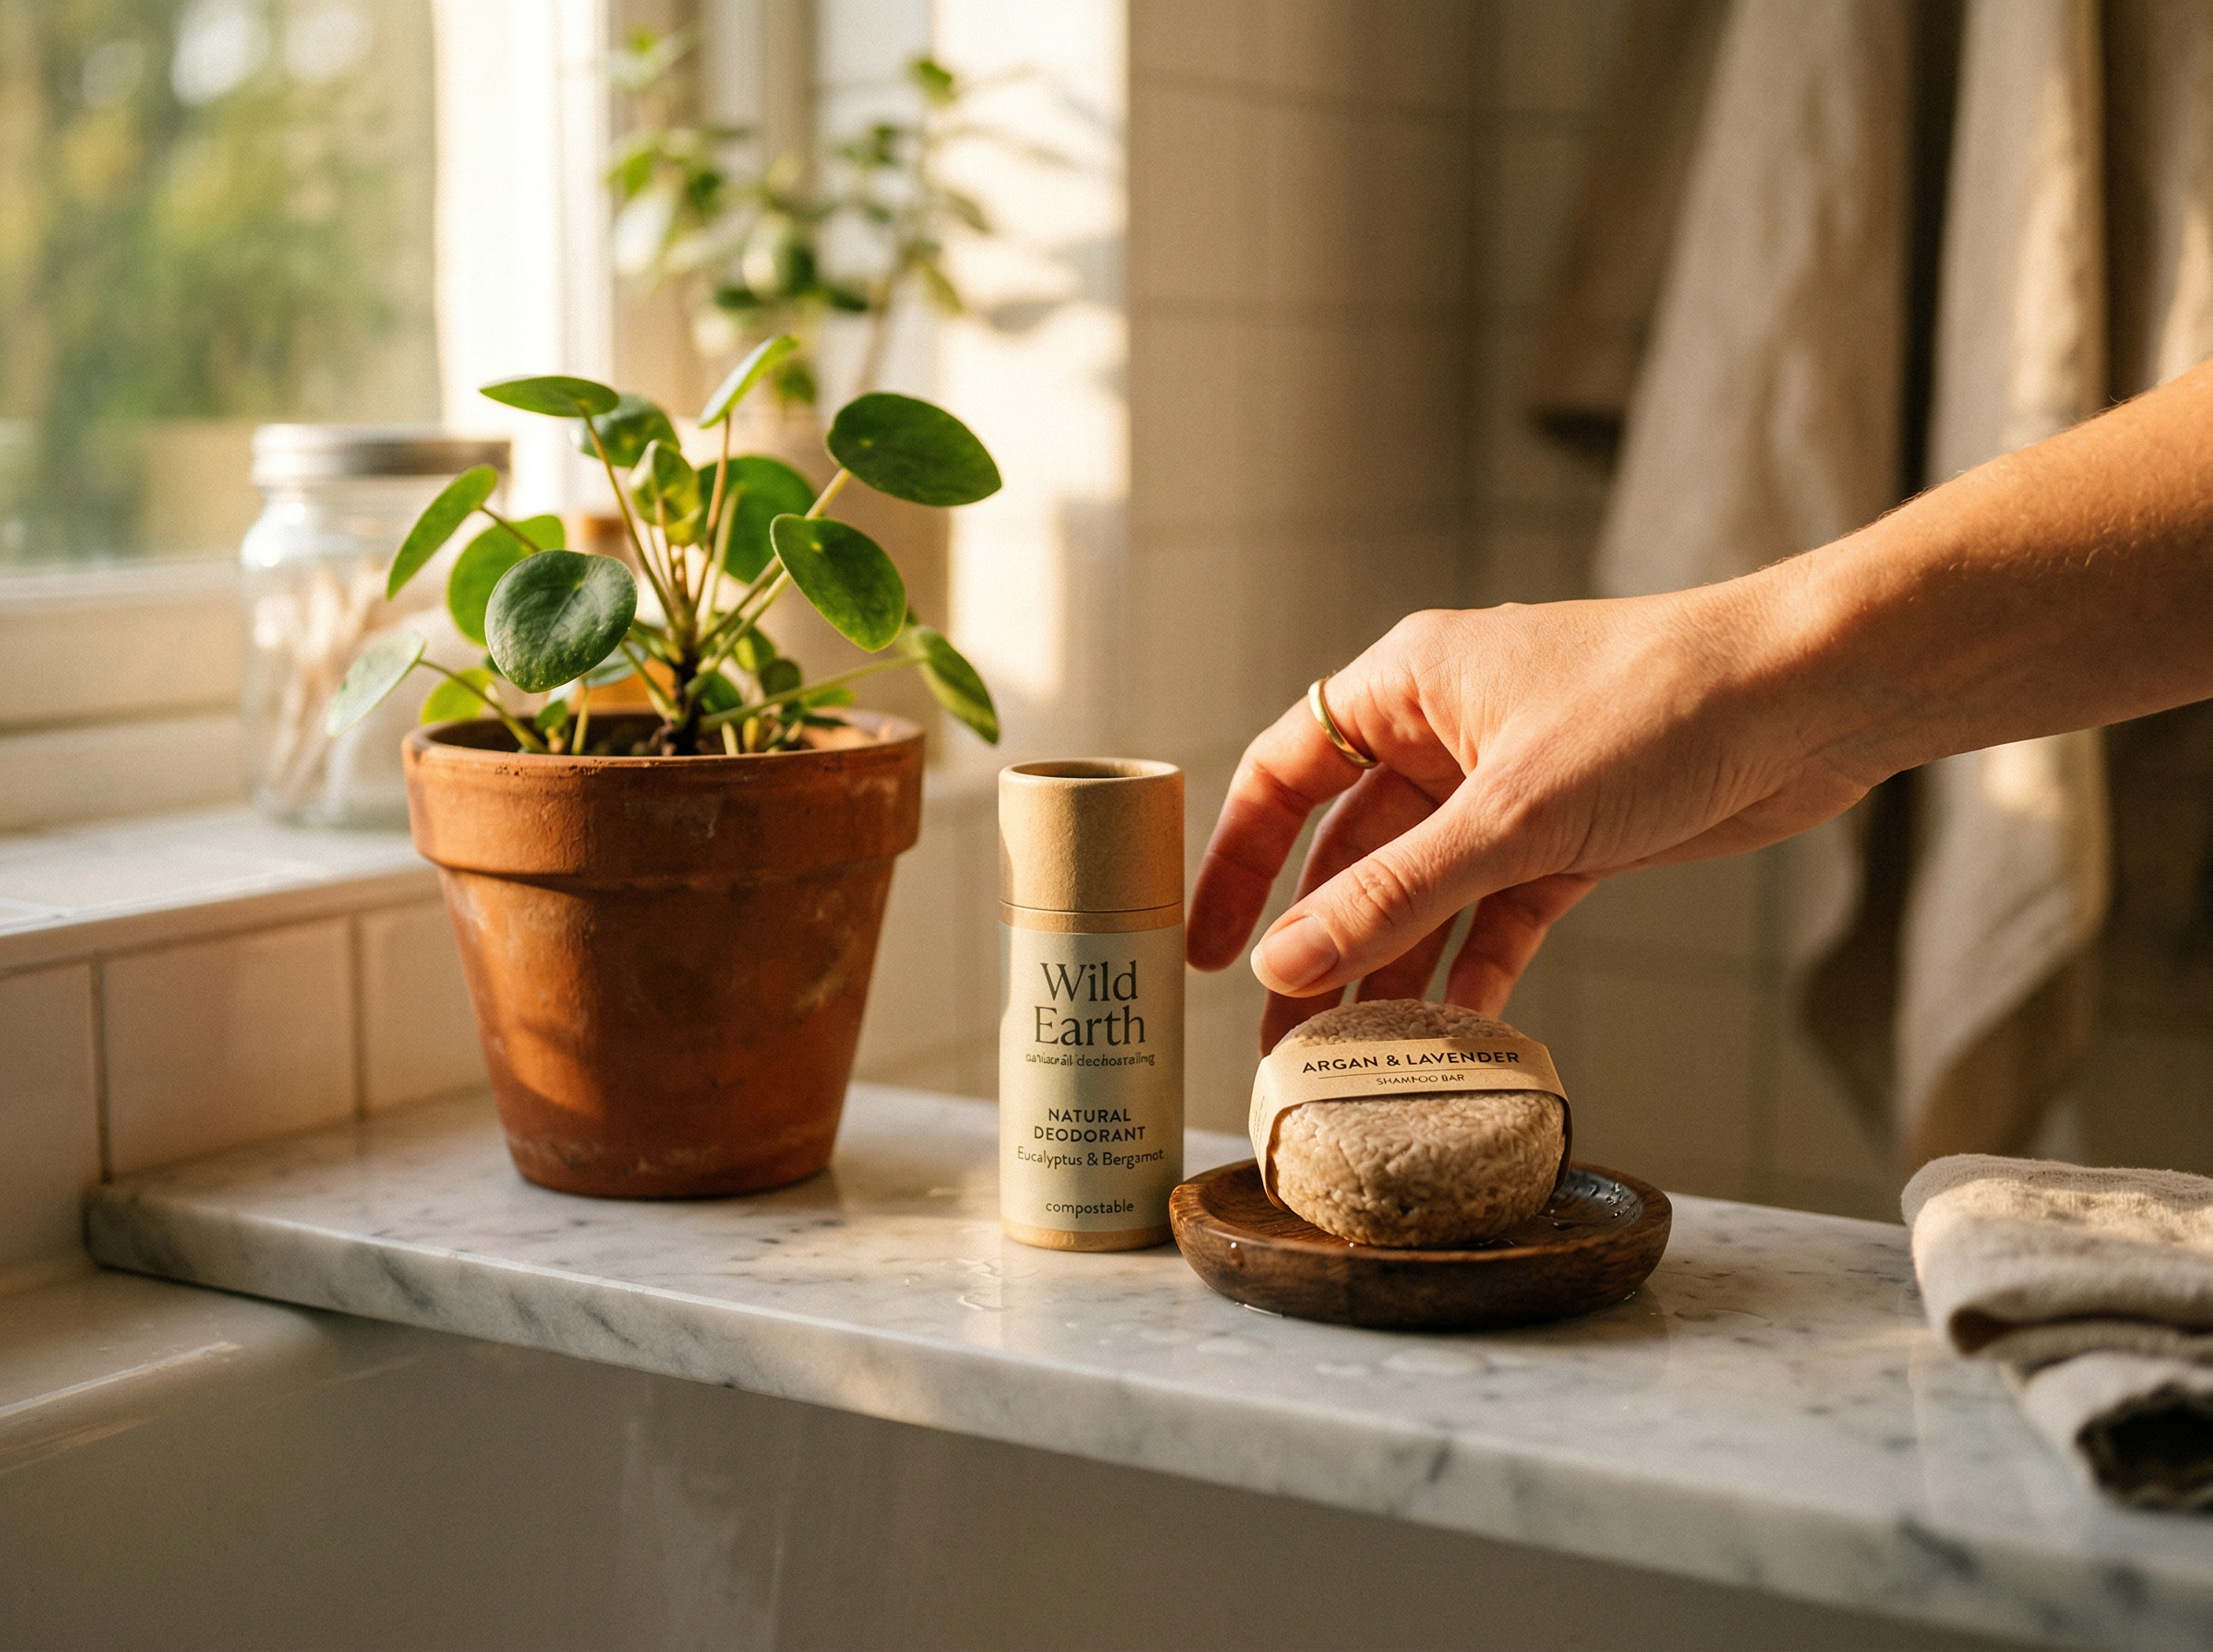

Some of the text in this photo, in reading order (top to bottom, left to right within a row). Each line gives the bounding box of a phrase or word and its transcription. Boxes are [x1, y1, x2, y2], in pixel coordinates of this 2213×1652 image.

[1040, 960, 1138, 1002] Wild
[1034, 1005, 1146, 1046] Earth
[1302, 1052, 1520, 1074] ARGAN & LAVENDER
[1048, 1108, 1131, 1123] NATURAL
[1034, 1126, 1146, 1143] DEODORANT
[1017, 1146, 1164, 1170] Eucalyptus & Bergamot
[1046, 1198, 1134, 1219] compostable
